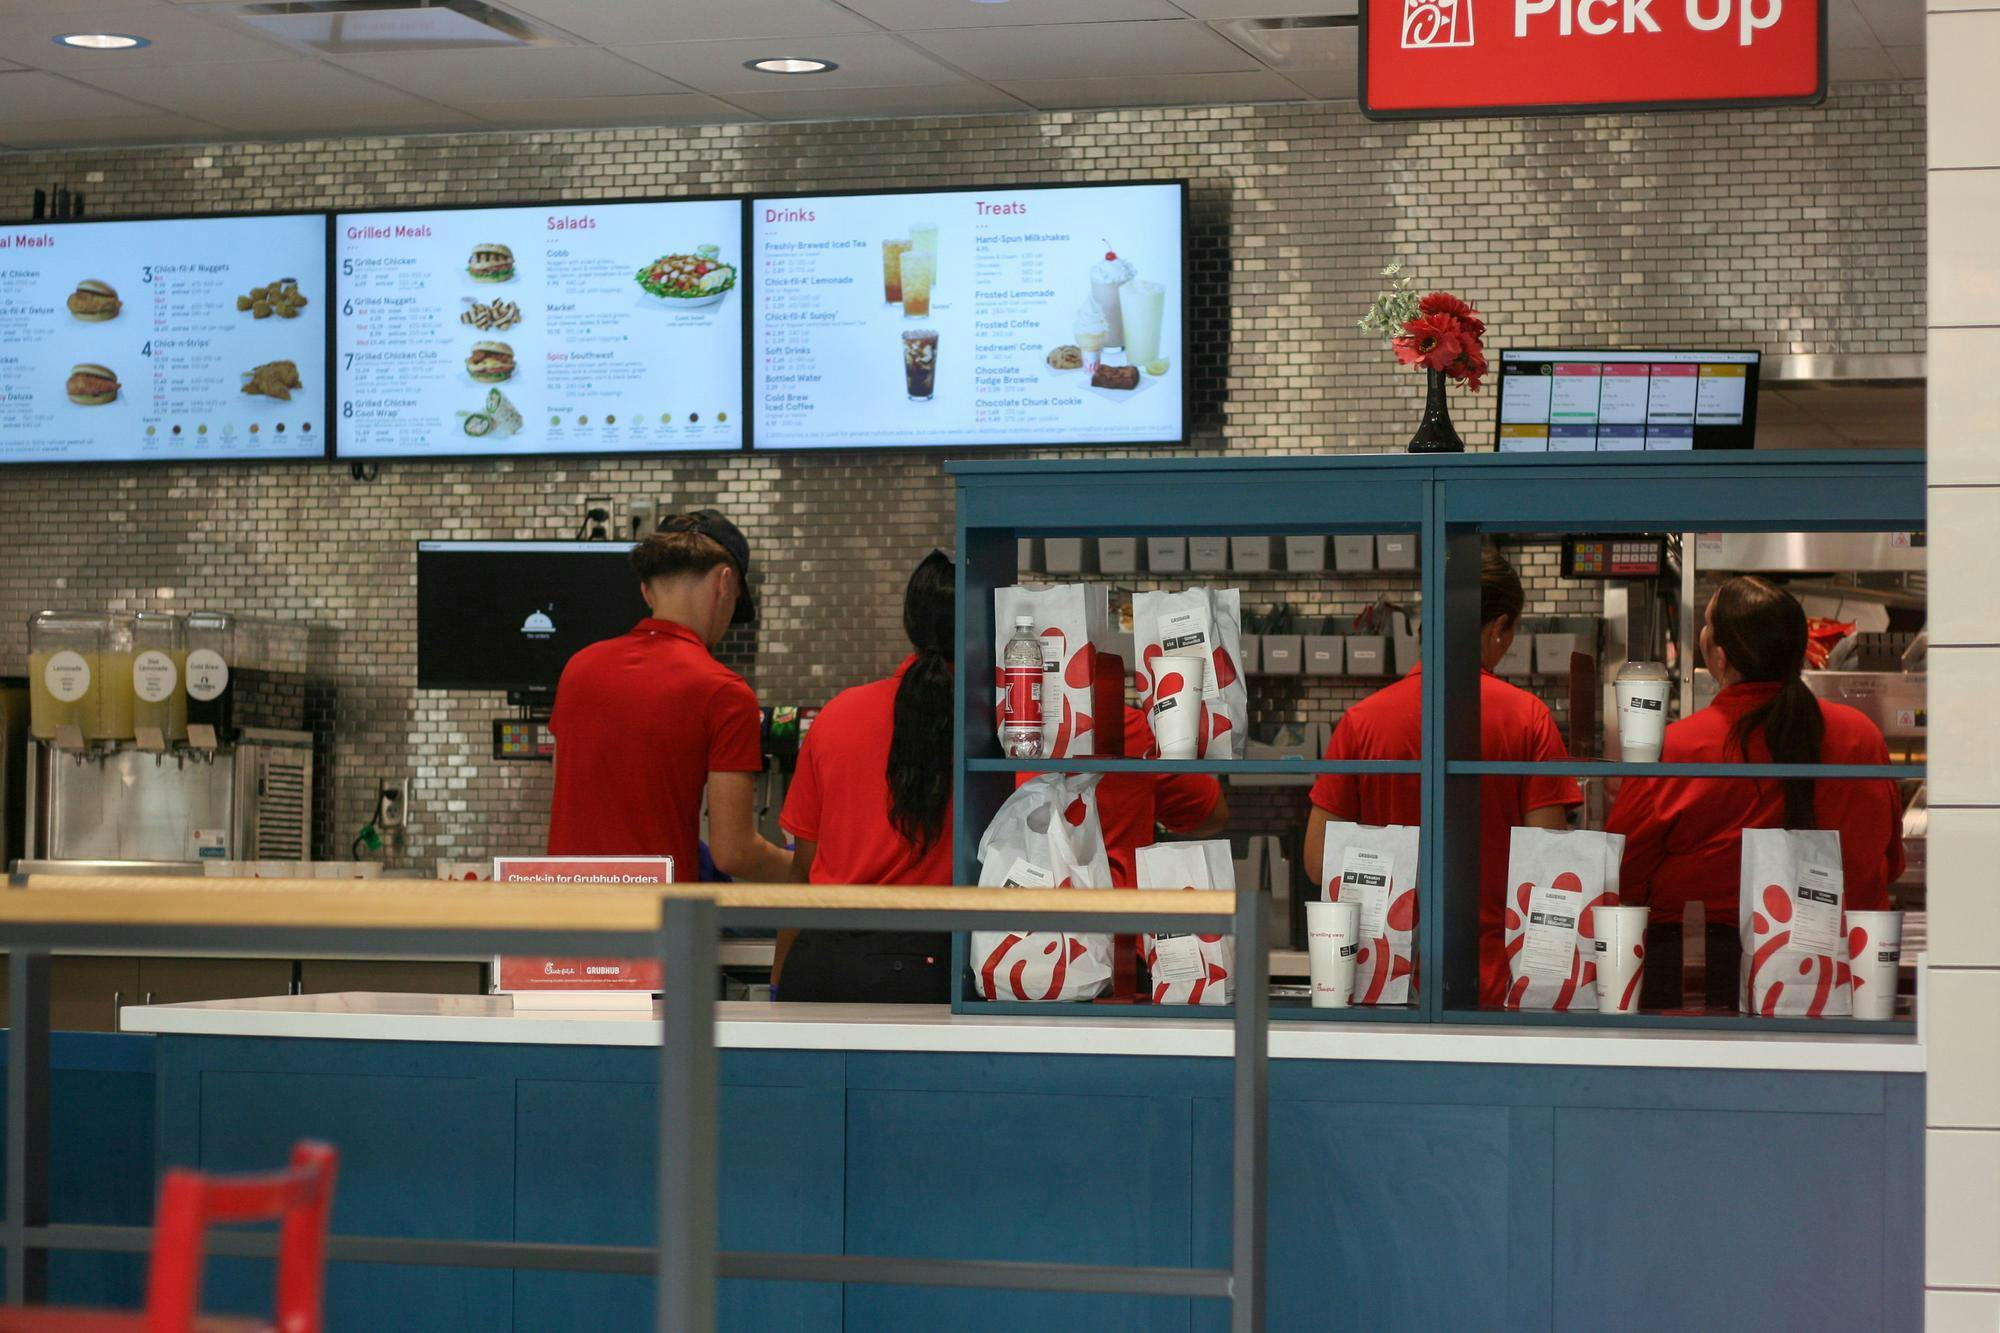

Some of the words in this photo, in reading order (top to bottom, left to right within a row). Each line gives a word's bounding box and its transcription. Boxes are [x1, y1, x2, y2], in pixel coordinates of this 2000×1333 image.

[1514, 0, 1662, 37] Pick
[1685, 0, 1782, 46] Up
[976, 201, 1027, 215] Treats
[766, 208, 816, 222] Drinks
[547, 216, 597, 230] Salads
[347, 225, 391, 240] Grilled
[394, 225, 432, 237] Meals
[975, 235, 1023, 244] Hand-Spun
[1023, 233, 1070, 241] Milkshakes
[16, 233, 55, 247] Meals
[343, 258, 353, 276] 5
[384, 257, 417, 265] Chicken
[142, 267, 152, 283] 3
[810, 276, 854, 284] Lemonade
[975, 290, 1008, 298] Frosted
[1010, 289, 1056, 297] Lemonade
[343, 298, 353, 316] 6
[384, 297, 417, 305] Nuggets
[975, 320, 1008, 328] Frosted
[141, 341, 152, 358] 4
[546, 352, 569, 360] Spicy
[570, 351, 615, 359] Southwest
[344, 353, 354, 370] 7
[975, 366, 1020, 374] Chocolate
[975, 376, 1001, 384] Fudge
[975, 399, 1020, 407] Chocolate
[1051, 397, 1082, 405] Cookie
[343, 401, 353, 418] 8
[508, 874, 555, 884] Check-in
[556, 874, 572, 884] for
[573, 874, 621, 884] Grubhub
[622, 874, 658, 884] Orders
[586, 966, 620, 975] GRUBHUB
